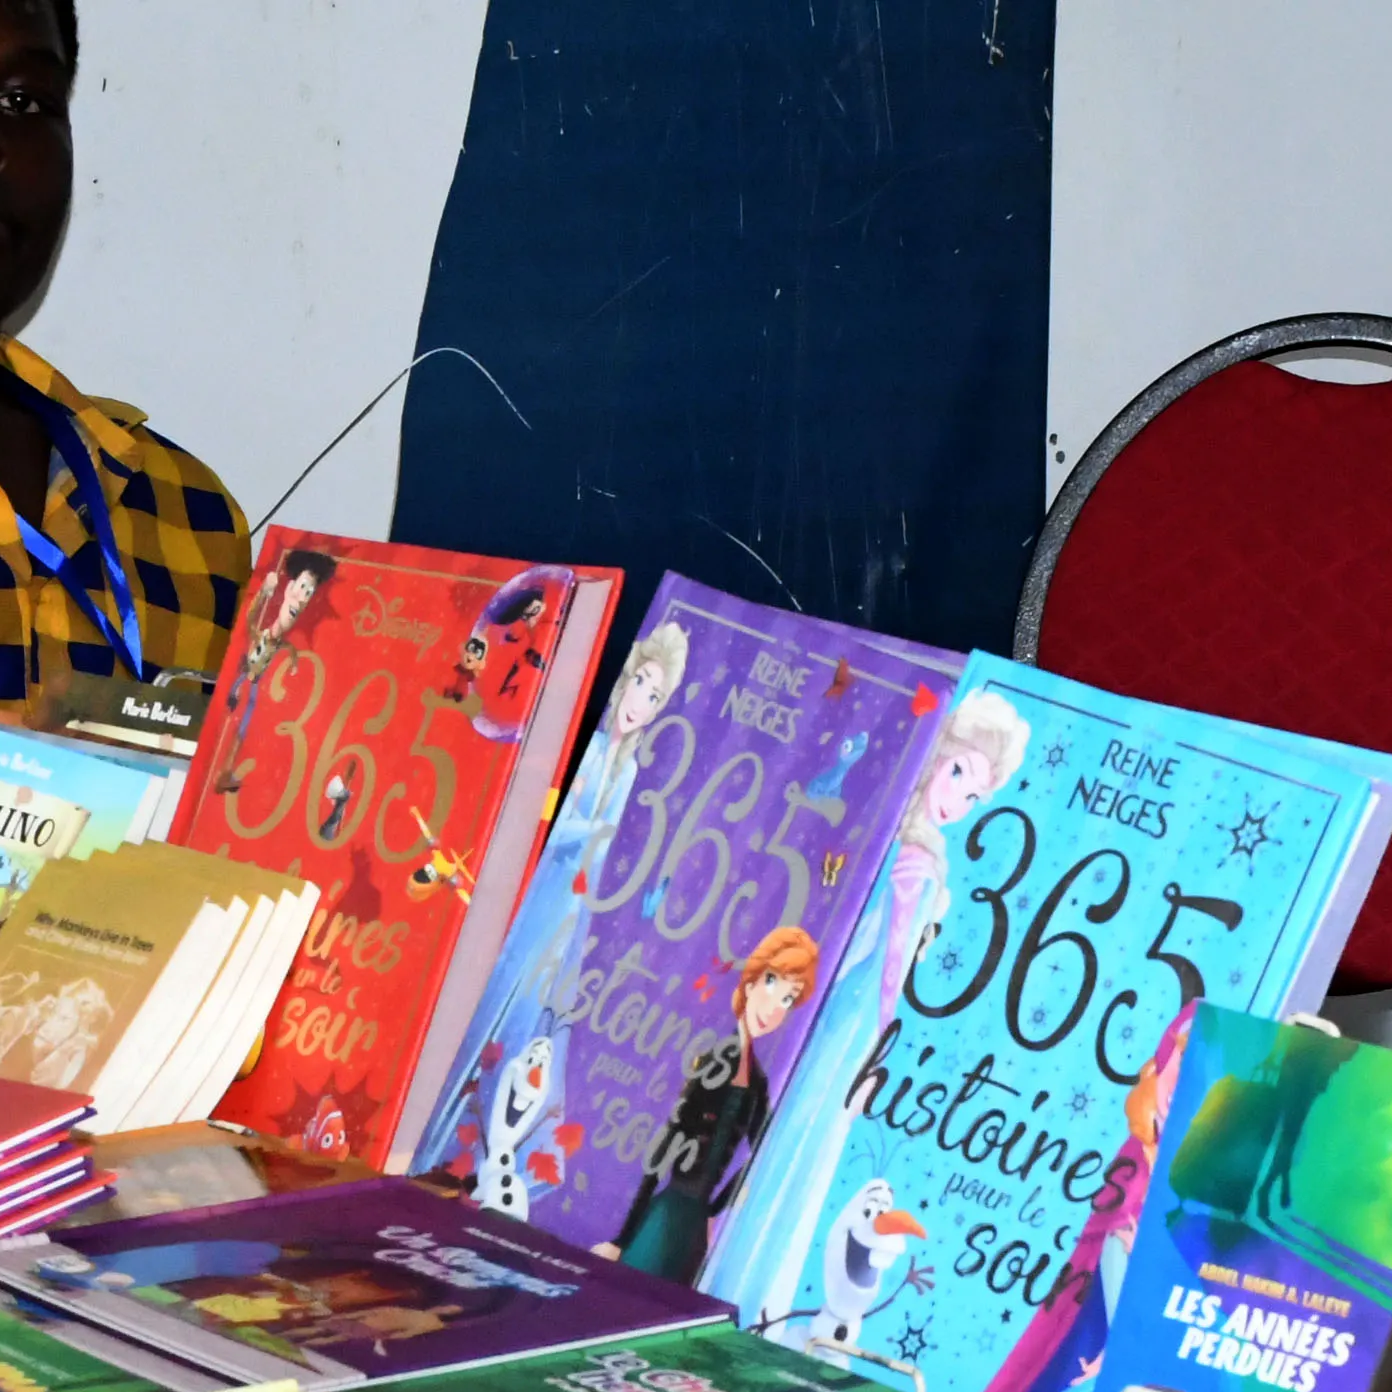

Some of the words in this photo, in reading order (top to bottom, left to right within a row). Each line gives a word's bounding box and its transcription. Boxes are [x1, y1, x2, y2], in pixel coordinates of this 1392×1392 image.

[748, 650, 806, 697] REINE
[225, 651, 483, 864] 365
[719, 690, 804, 744] NEIGES
[1101, 738, 1184, 789] REINE
[584, 715, 846, 969] 365
[1067, 777, 1175, 841] NEIGES
[903, 807, 1243, 1085] 365
[276, 983, 377, 1063] soir
[524, 915, 740, 1089] histoires
[588, 1095, 698, 1180] soir
[844, 1018, 1139, 1215] histoires
[941, 1170, 1010, 1213] pour
[1019, 1187, 1047, 1229] le
[955, 1224, 1097, 1310] soir
[1162, 1286, 1221, 1328] LES
[1221, 1302, 1356, 1367] ANNÉES
